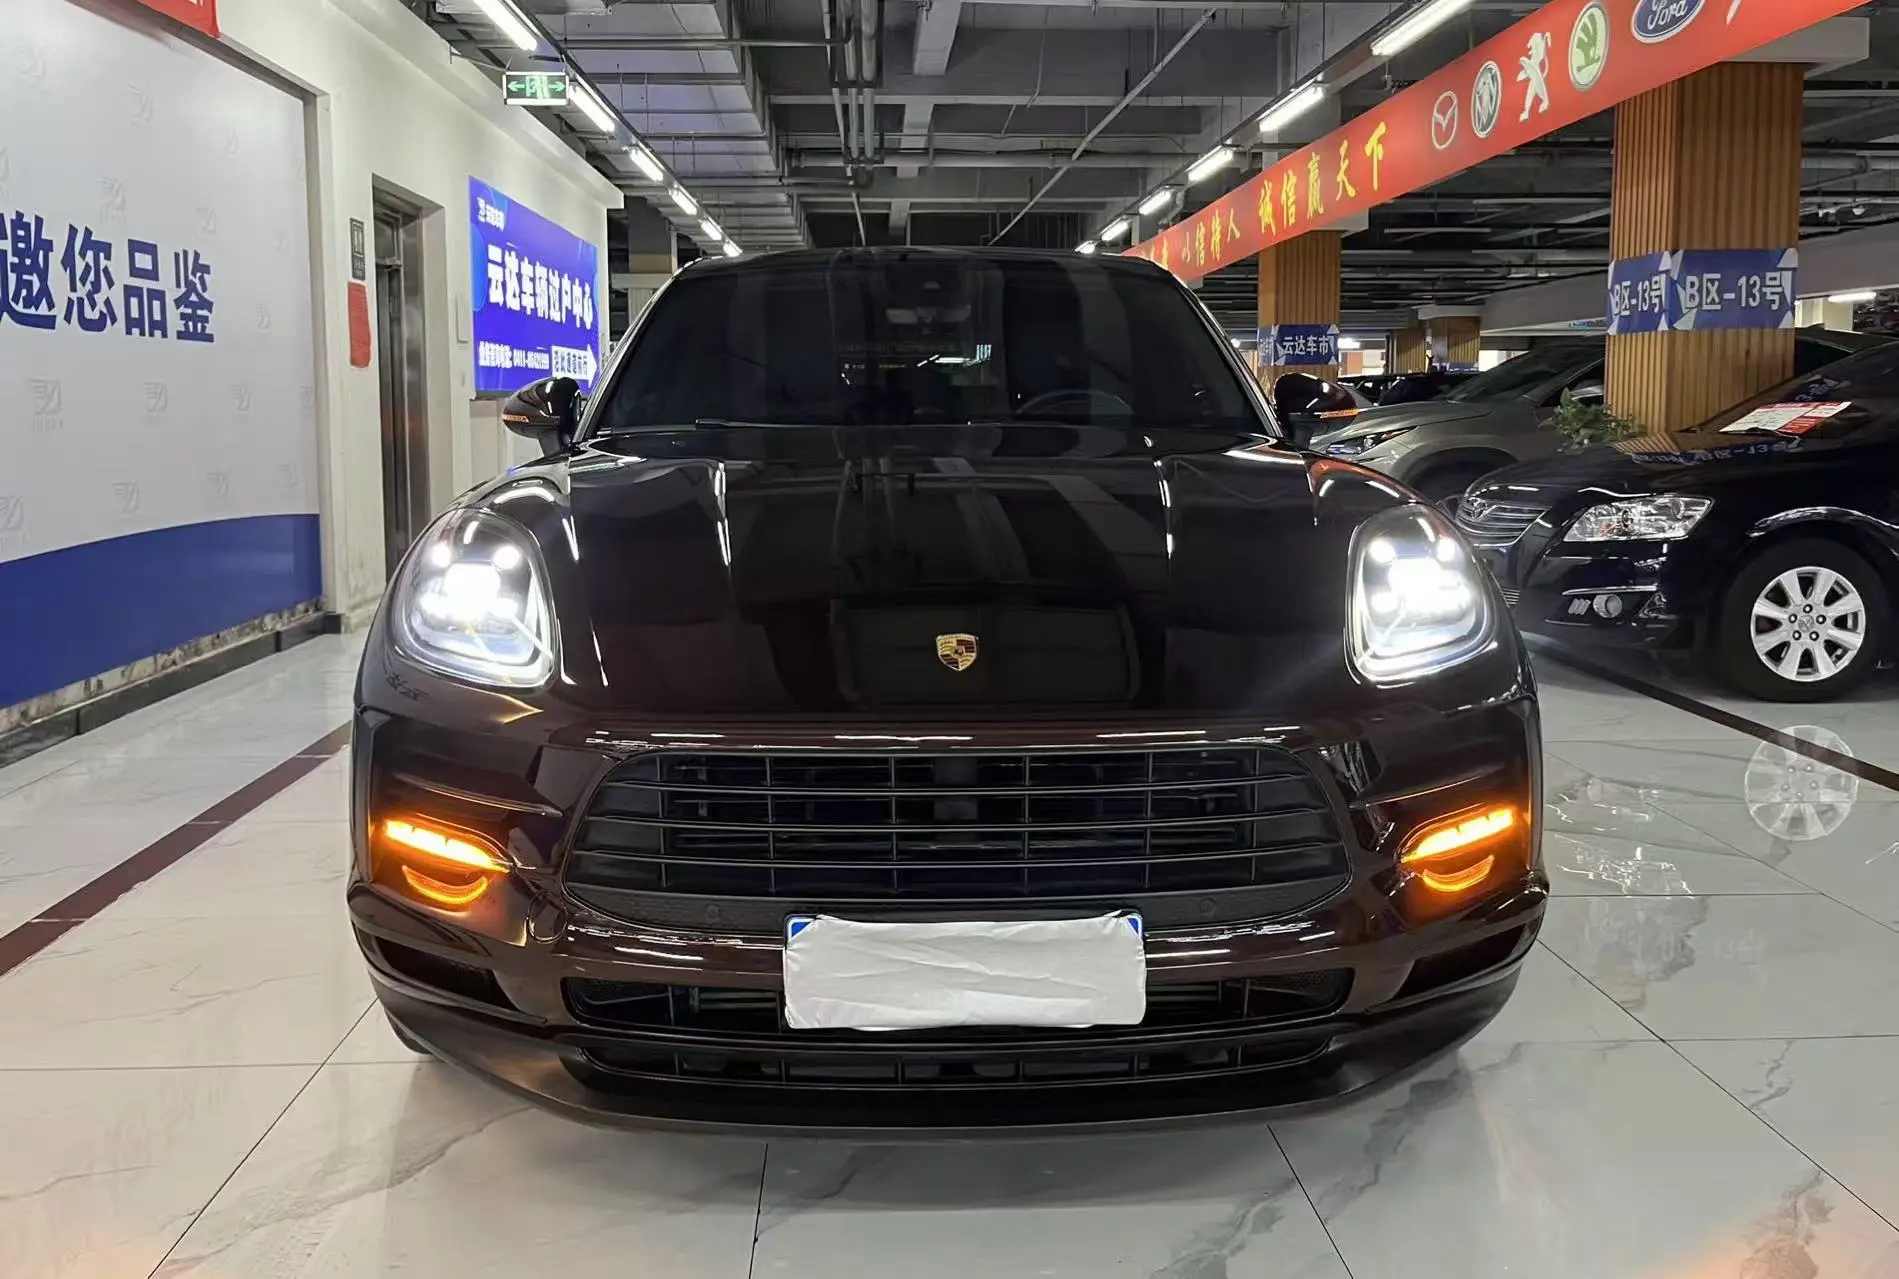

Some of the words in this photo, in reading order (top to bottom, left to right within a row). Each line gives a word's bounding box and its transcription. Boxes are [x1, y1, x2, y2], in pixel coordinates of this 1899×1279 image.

[1258, 121, 1387, 236] 诚信赢天下
[487, 243, 593, 330] 云达车辆过户中心
[1613, 274, 1662, 316] B区-13号
[1685, 271, 1784, 311] B区-13号
[1282, 334, 1330, 356] 云达车市
